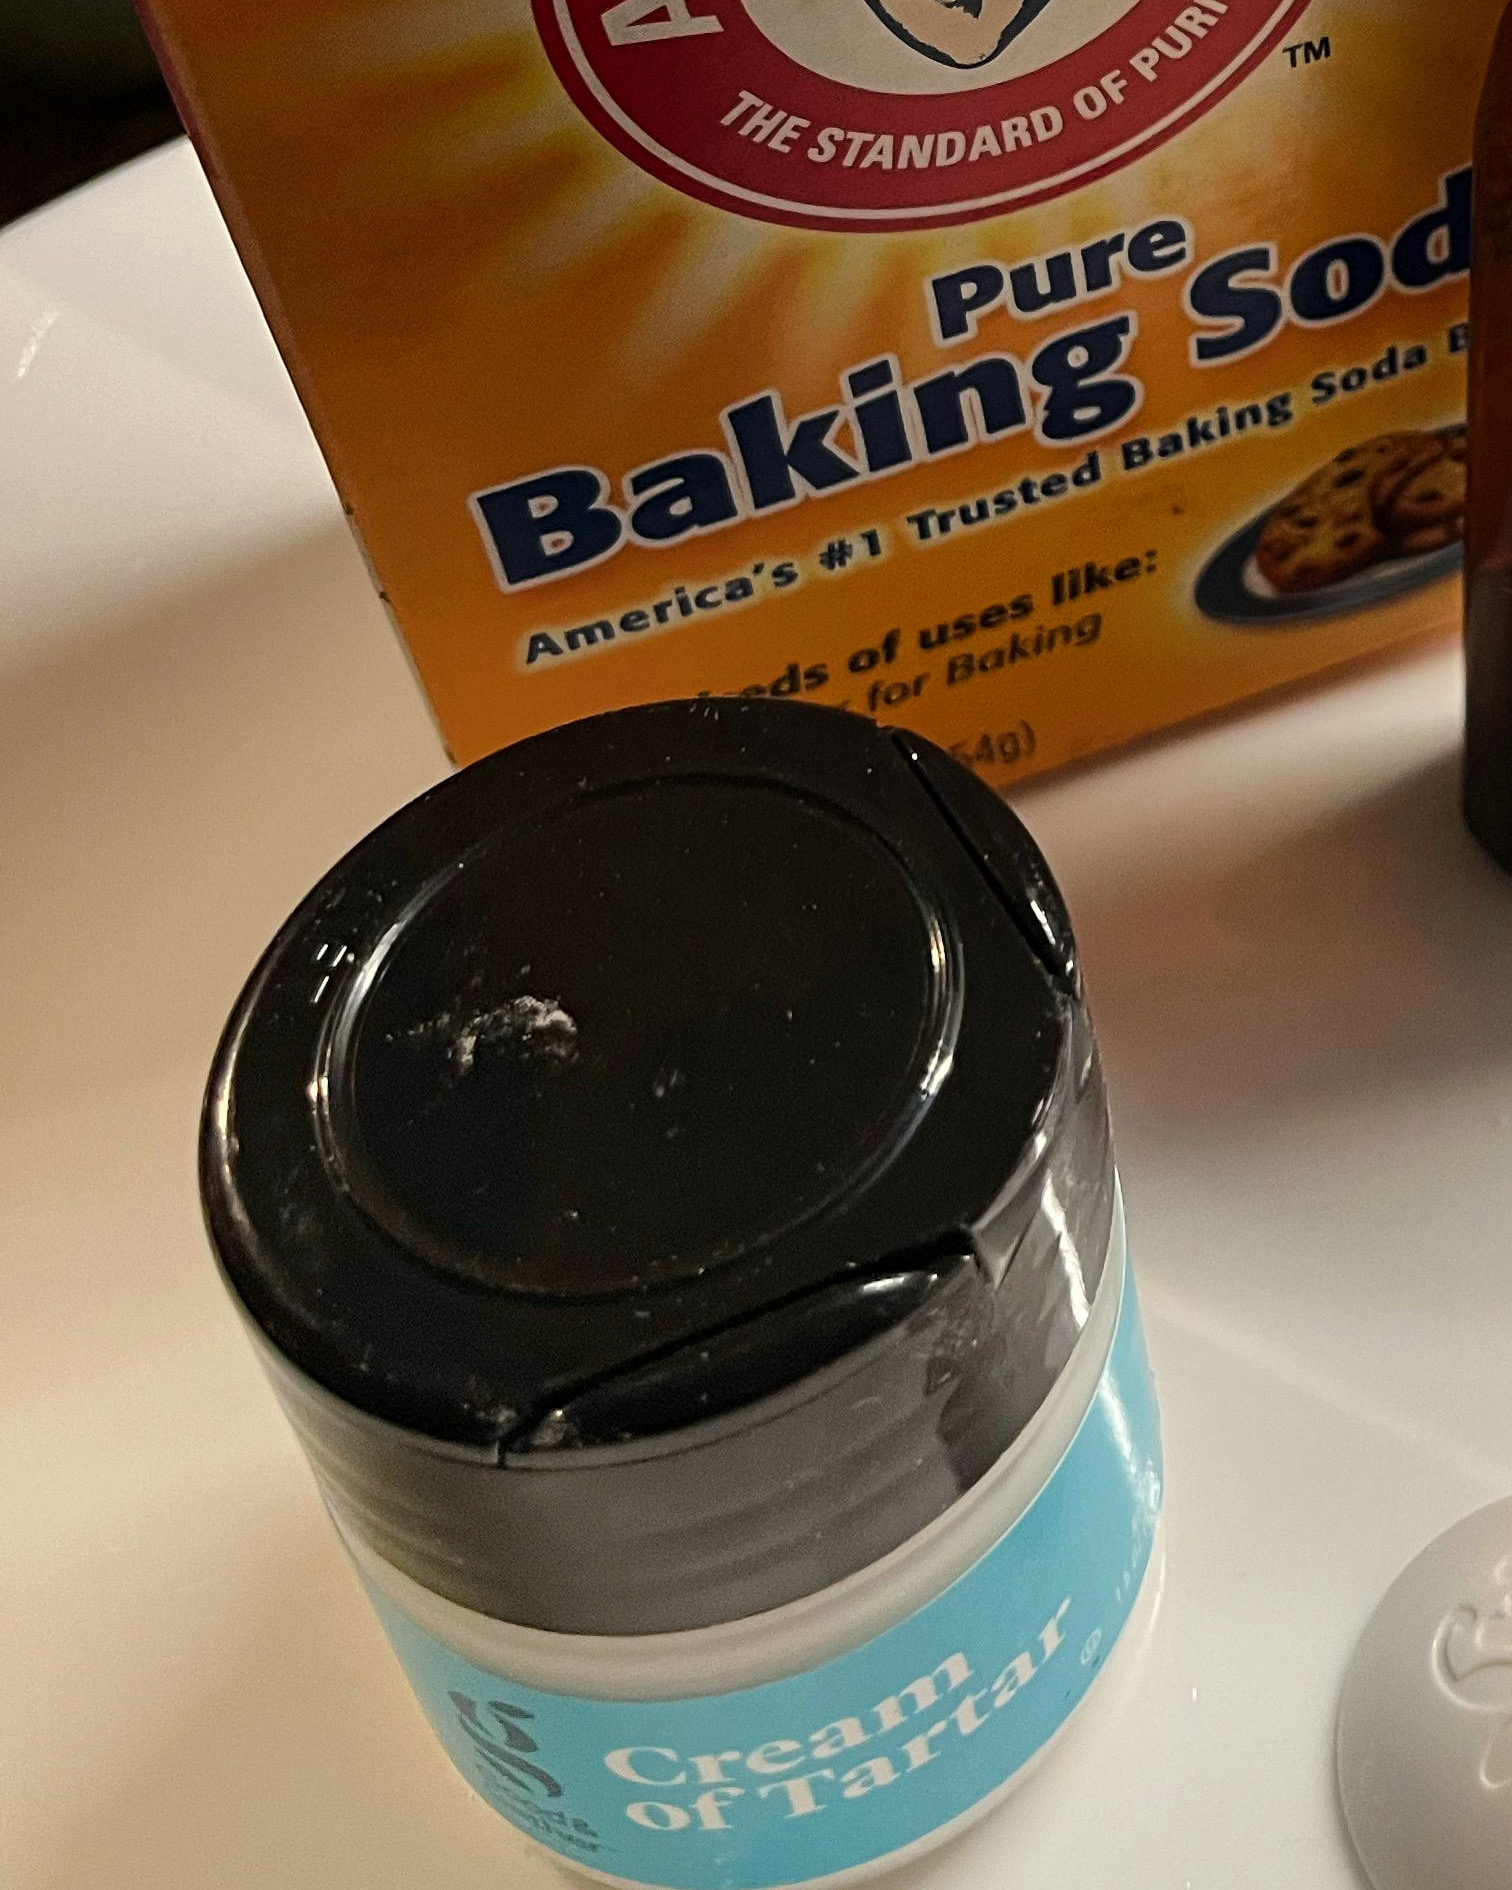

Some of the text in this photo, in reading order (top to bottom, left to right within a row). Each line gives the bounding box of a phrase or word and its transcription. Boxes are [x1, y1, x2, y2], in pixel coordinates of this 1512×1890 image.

[1282, 37, 1331, 68] TM
[720, 90, 811, 153] THE
[807, 104, 1064, 170] STANDARD
[1073, 70, 1130, 121] OF
[932, 220, 1186, 338] Pure
[477, 167, 1472, 585] Baking Sod
[525, 341, 1428, 665] America's #1 Trusted Baking Soda
[848, 629, 902, 674] of
[919, 592, 1034, 651] uses
[1051, 548, 1158, 608] like:
[867, 613, 1102, 712] for Baking
[603, 1647, 976, 1790] Cream
[624, 1786, 745, 1833] of
[757, 1595, 1073, 1822] Tartar
